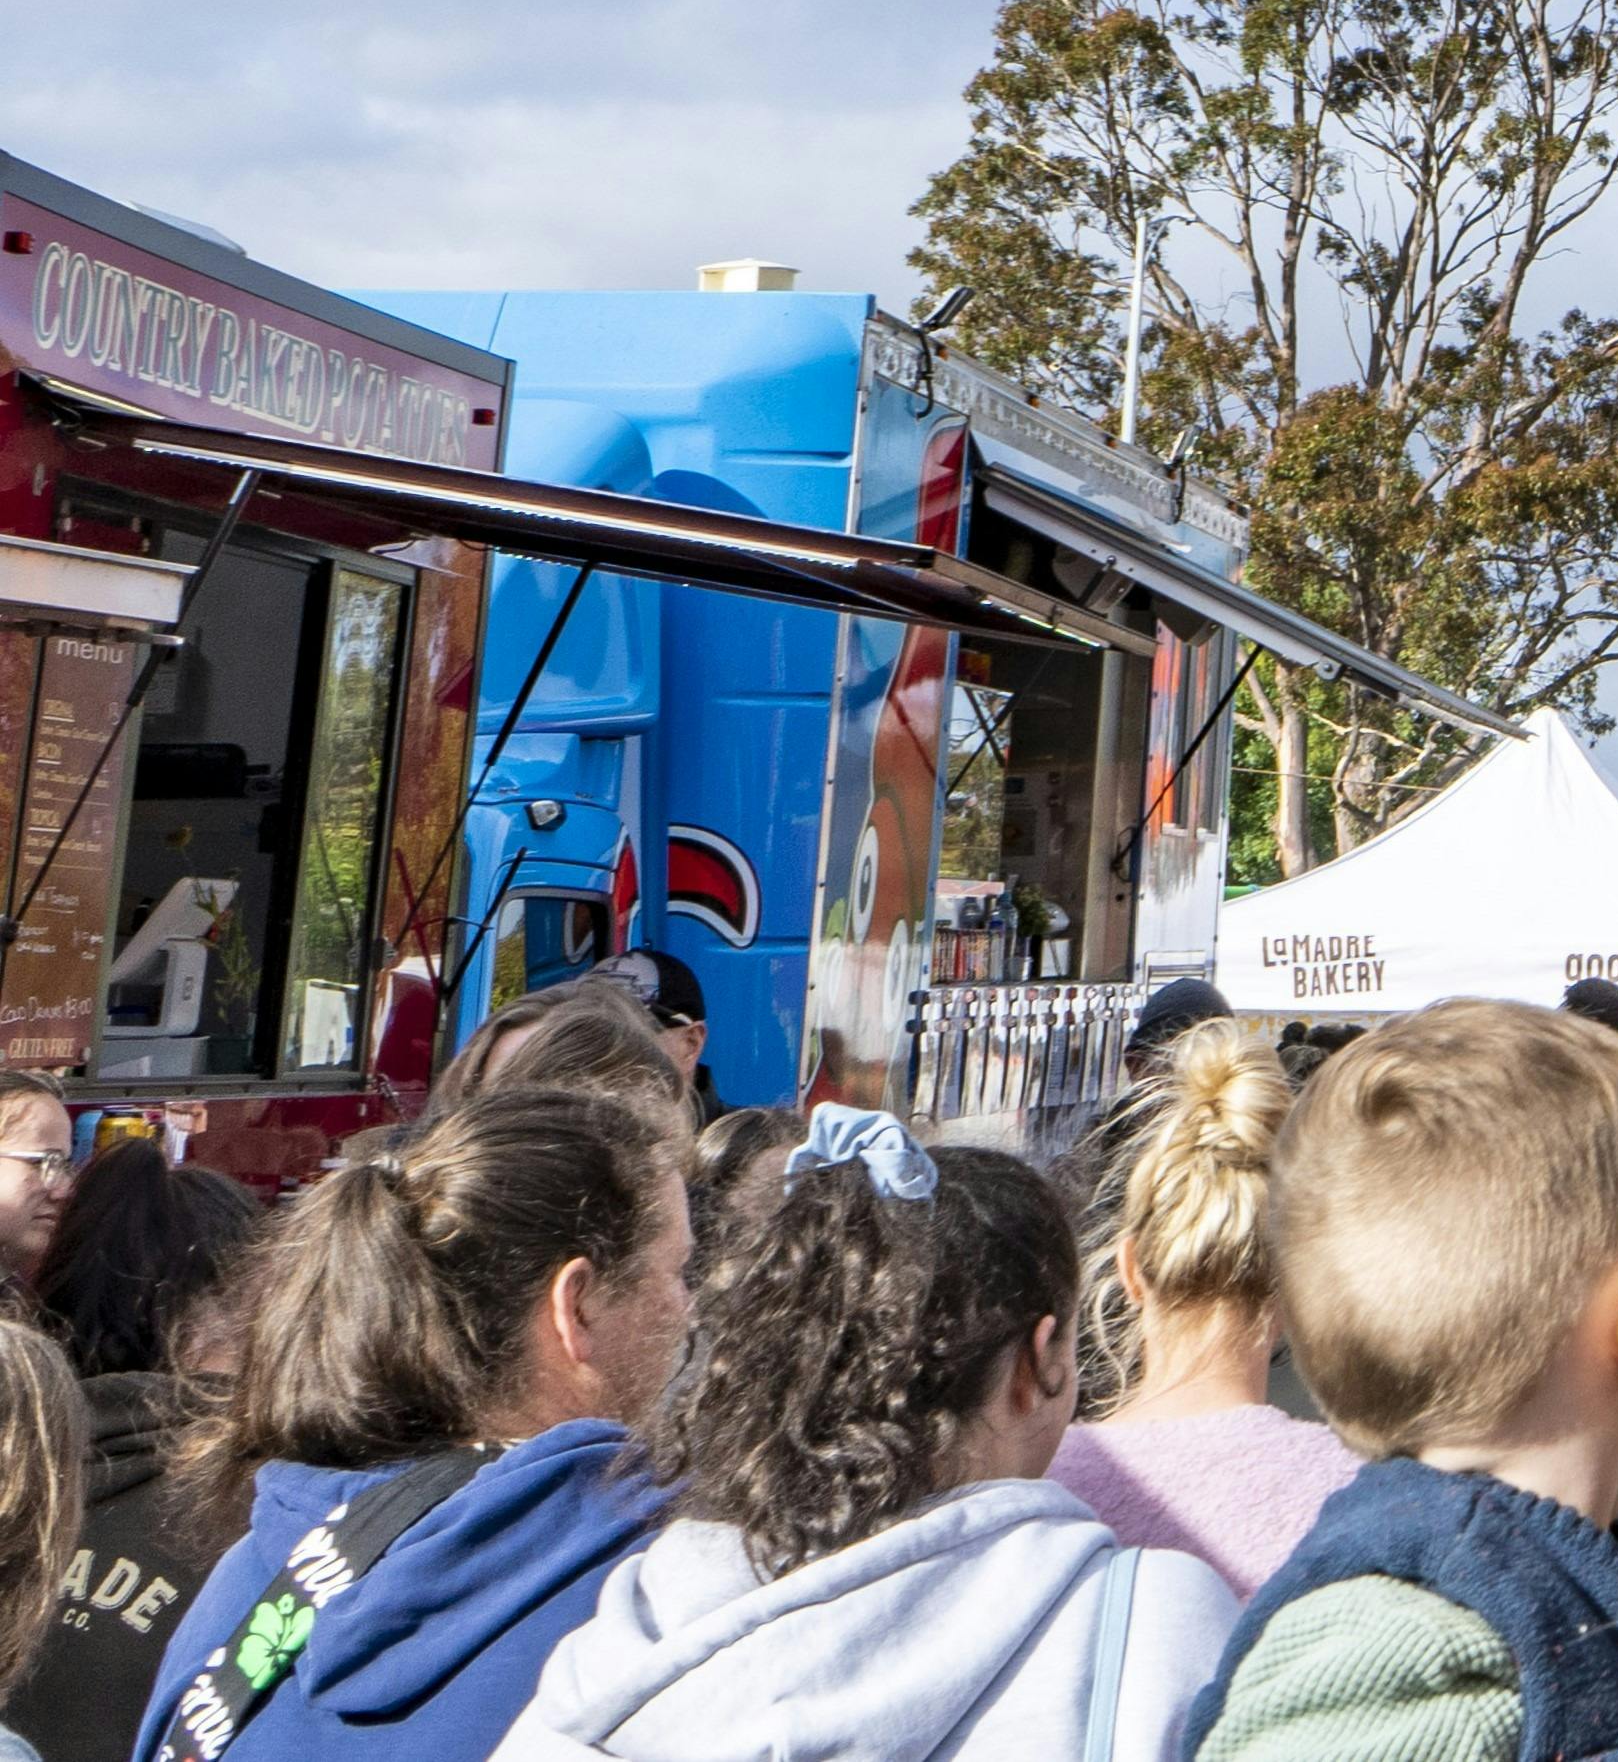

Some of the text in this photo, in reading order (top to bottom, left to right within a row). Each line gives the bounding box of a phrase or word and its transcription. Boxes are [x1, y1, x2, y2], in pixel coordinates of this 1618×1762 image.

[33, 242, 470, 467] COUNTRY BAKED POTATOES
[56, 639, 123, 664] menu
[1292, 934, 1376, 963] MADRE
[1293, 960, 1385, 998] BAKERY
[62, 1609, 91, 1631] CO.
